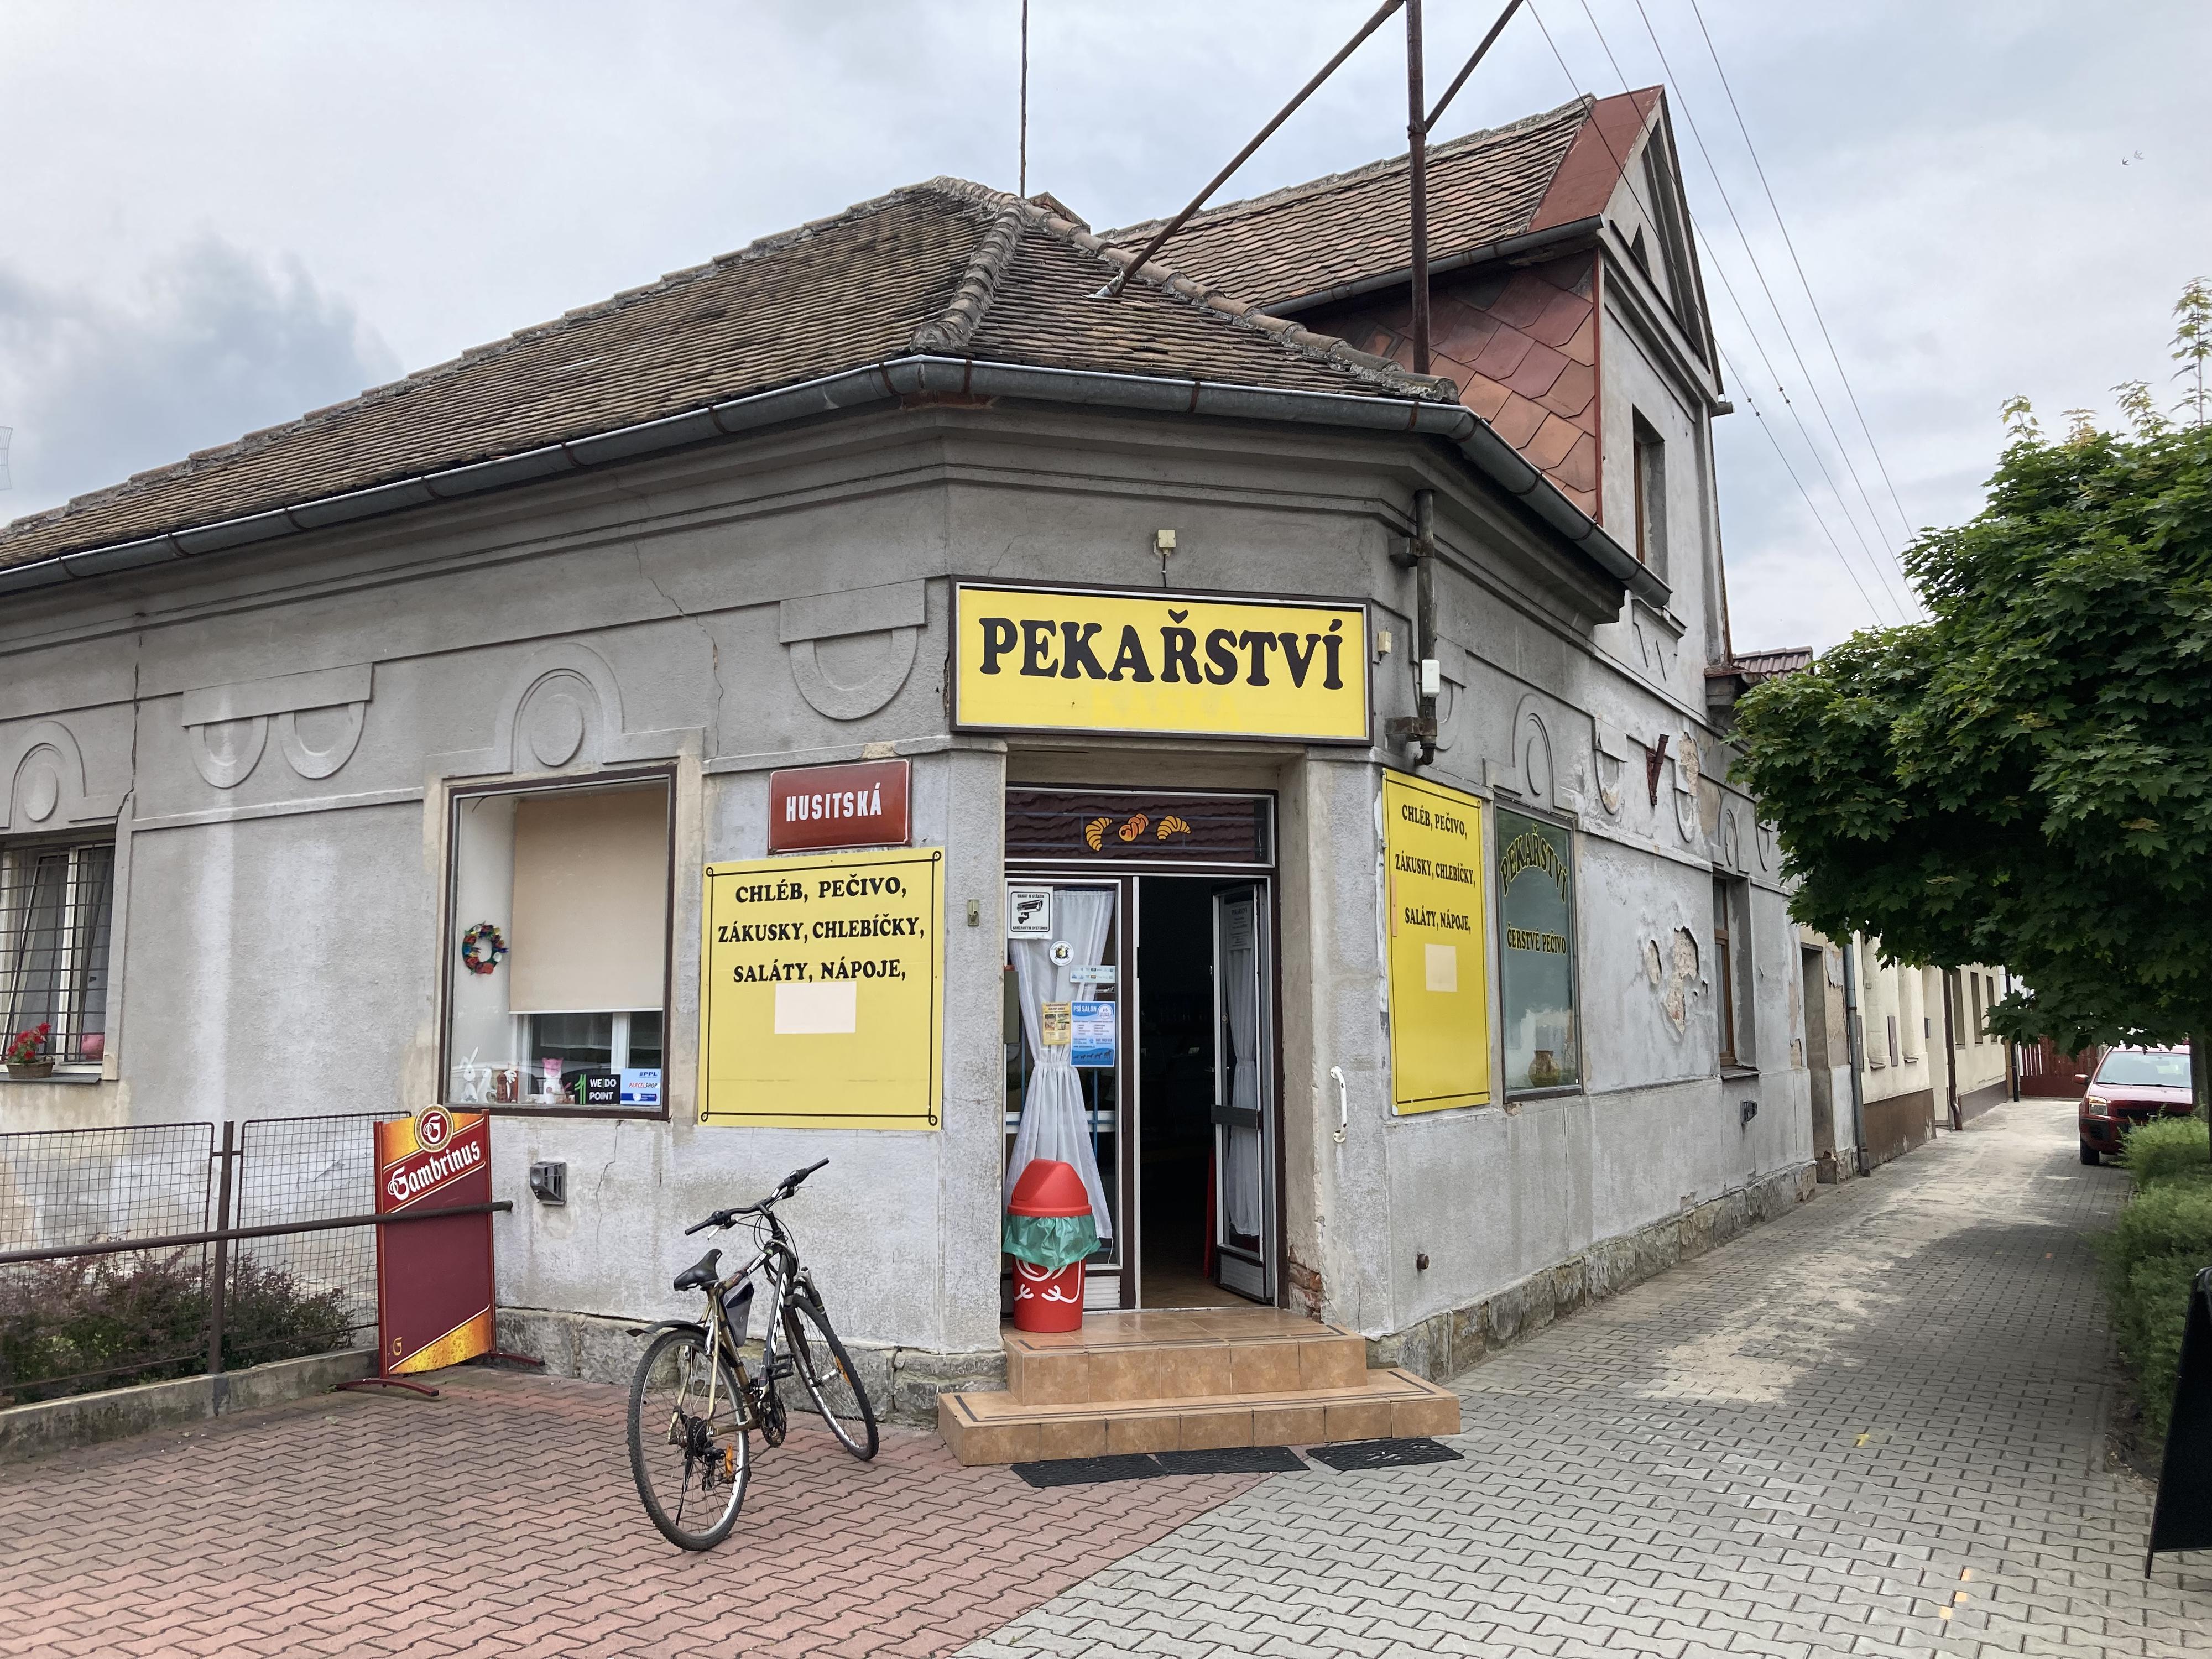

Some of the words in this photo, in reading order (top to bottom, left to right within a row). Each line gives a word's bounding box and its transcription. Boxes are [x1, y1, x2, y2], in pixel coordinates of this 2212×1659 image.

[979, 609, 1344, 690] PEKAŘSTVÍ
[786, 782, 882, 822] HUSITSKÁ
[1402, 804, 1433, 831] CHLÉB,
[1434, 811, 1467, 840] PEČIVO,
[1395, 850, 1434, 880] ZÁKUSKY,
[1436, 863, 1476, 888] CHLEBÍČKY,
[1500, 823, 1567, 904] PEKAŘSTVÍ
[735, 878, 808, 903] CHLÉB,
[818, 874, 907, 898] PEČIVO,
[718, 920, 808, 943] ZÁKUSKY,
[812, 913, 925, 940] CHLEBÍČKY,
[1405, 905, 1439, 931] SALÁTY,
[1440, 909, 1471, 935] NÁPOJE,
[1507, 921, 1540, 952] ČERSTVÉ
[1542, 929, 1567, 956] PEČIVO
[733, 959, 813, 983] SALÁTY,
[821, 956, 906, 981] NÁPOJE,
[589, 1092, 614, 1100] POINT
[387, 1141, 481, 1201] Gambrinus
